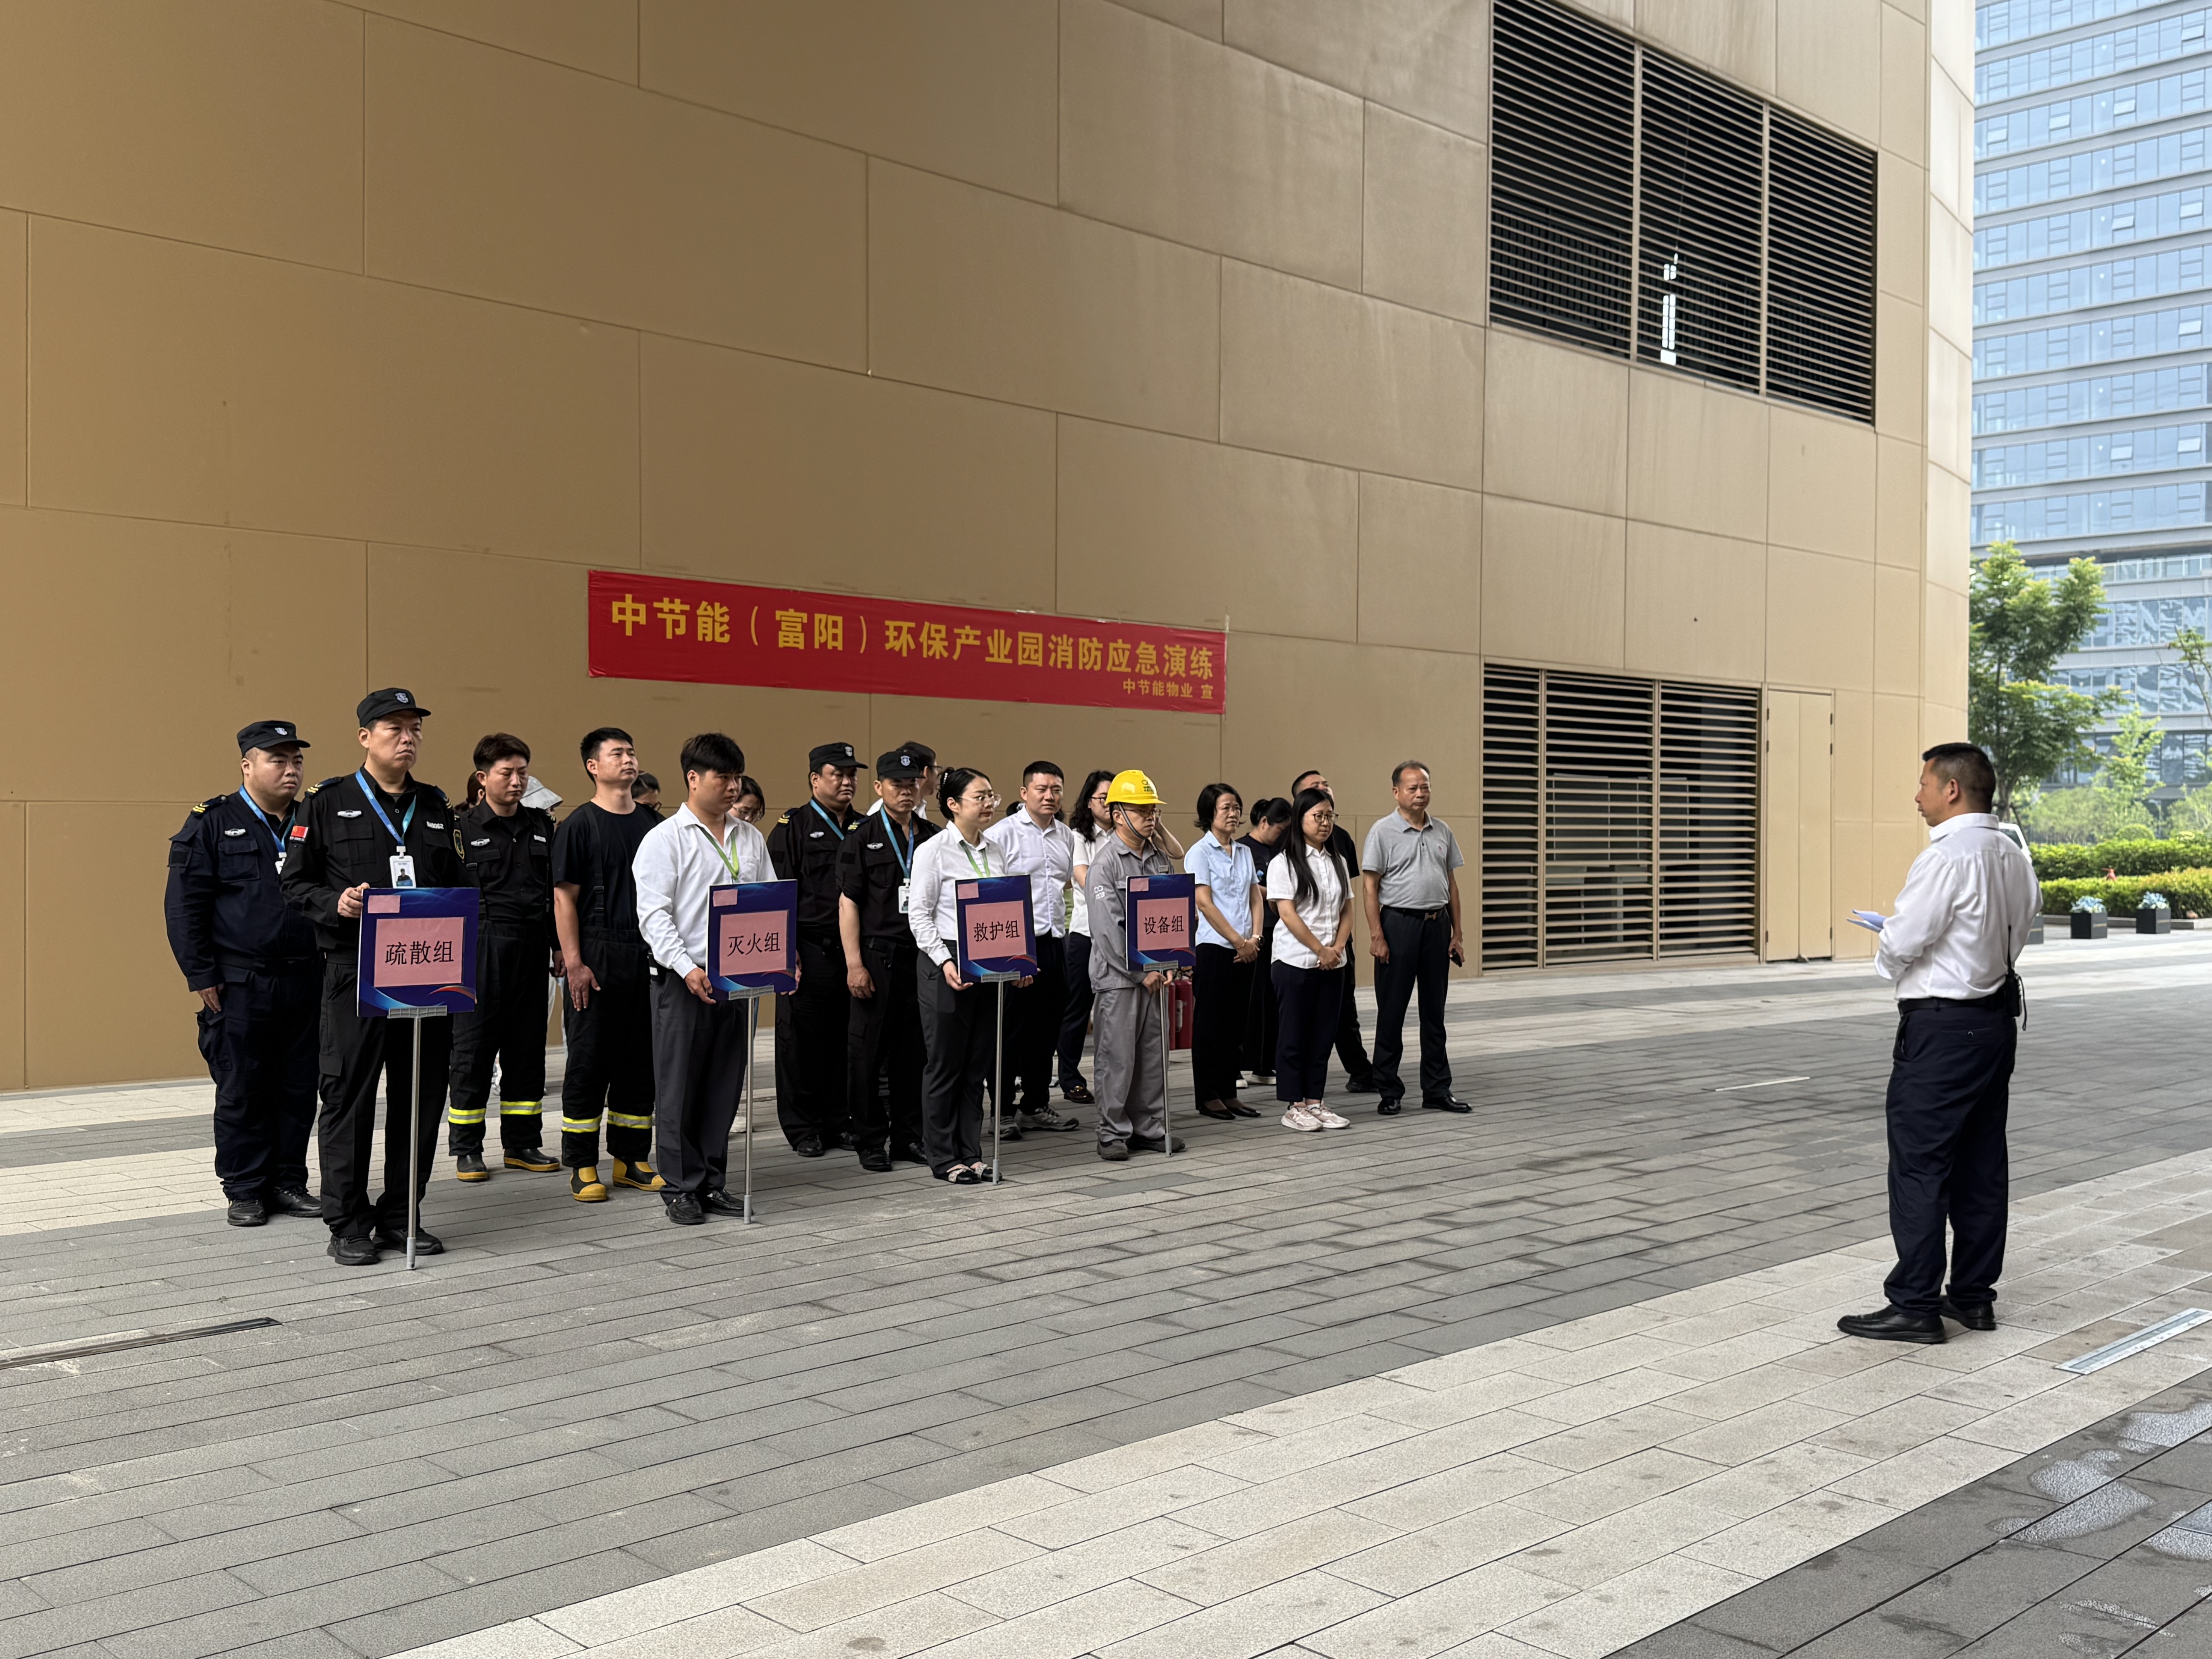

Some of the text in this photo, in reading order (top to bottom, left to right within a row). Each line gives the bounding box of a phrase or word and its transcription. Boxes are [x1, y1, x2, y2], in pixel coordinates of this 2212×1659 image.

[612, 593, 1214, 680] 中节能（富阳）环保产业园消防应急演练
[1123, 678, 1214, 699] 中节能物业 宣
[973, 920, 1020, 943] 救护组
[1143, 915, 1185, 935] 设备组
[385, 940, 455, 966] 疏散组
[727, 931, 781, 957] 灭火组
